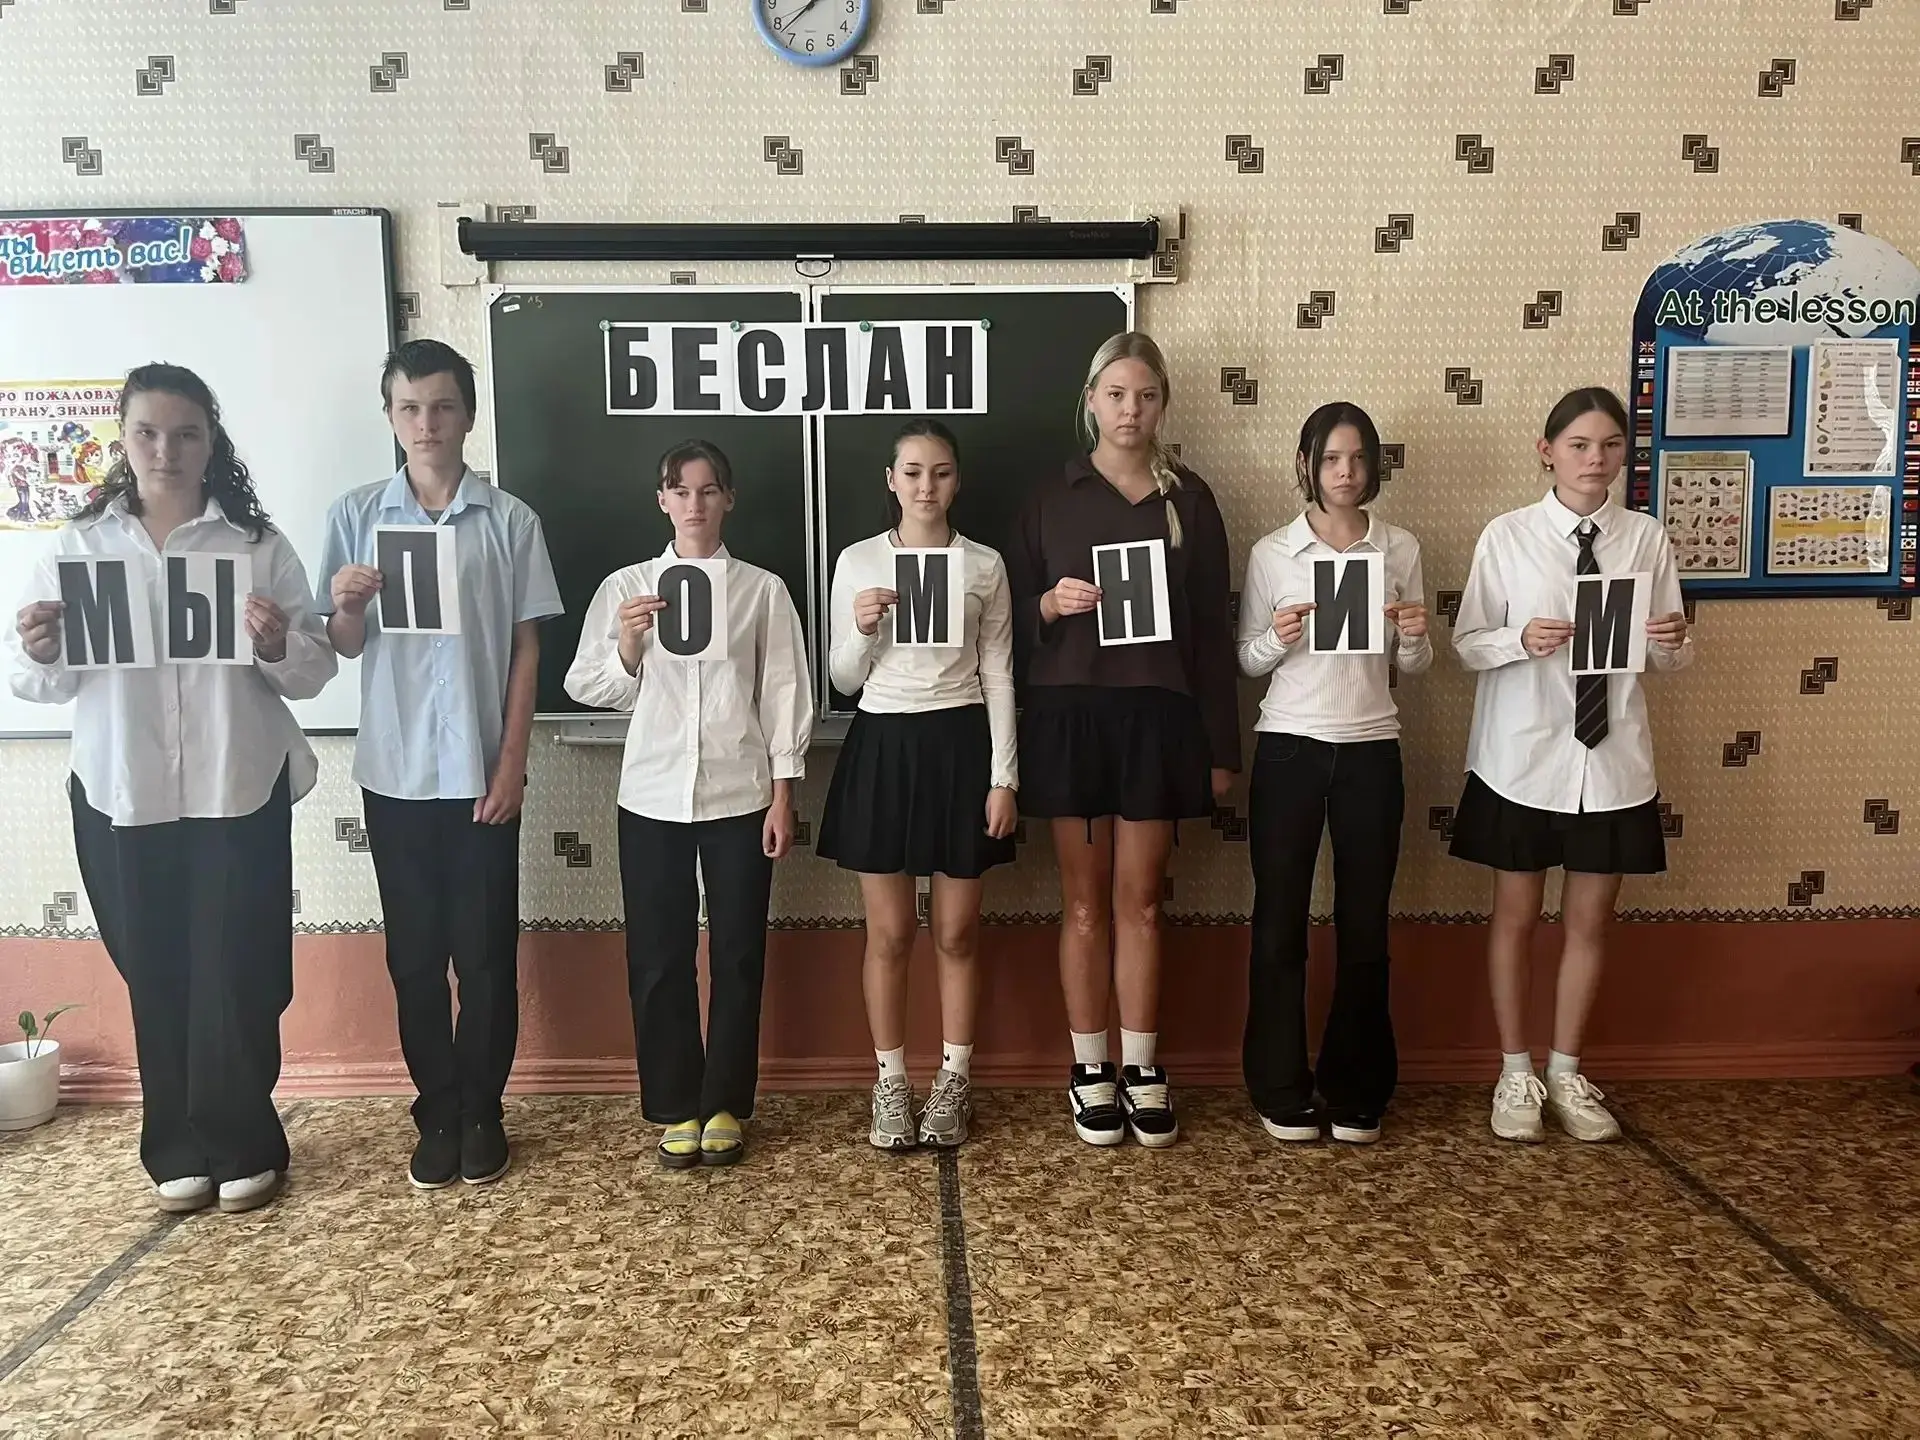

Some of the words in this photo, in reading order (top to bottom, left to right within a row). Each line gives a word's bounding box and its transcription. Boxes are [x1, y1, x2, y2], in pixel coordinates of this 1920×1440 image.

[845, 0, 855, 14] 3
[773, 17, 782, 30] 8
[840, 20, 848, 33] 4
[788, 32, 796, 46] 7
[805, 38, 815, 52] 6
[826, 34, 835, 47] 5
[9, 249, 120, 275] видеть
[130, 227, 190, 264] вас!
[1657, 290, 1702, 325] At
[1714, 290, 1777, 325] the
[1790, 290, 1915, 325] lesson
[609, 326, 974, 412] БЕСЛАН
